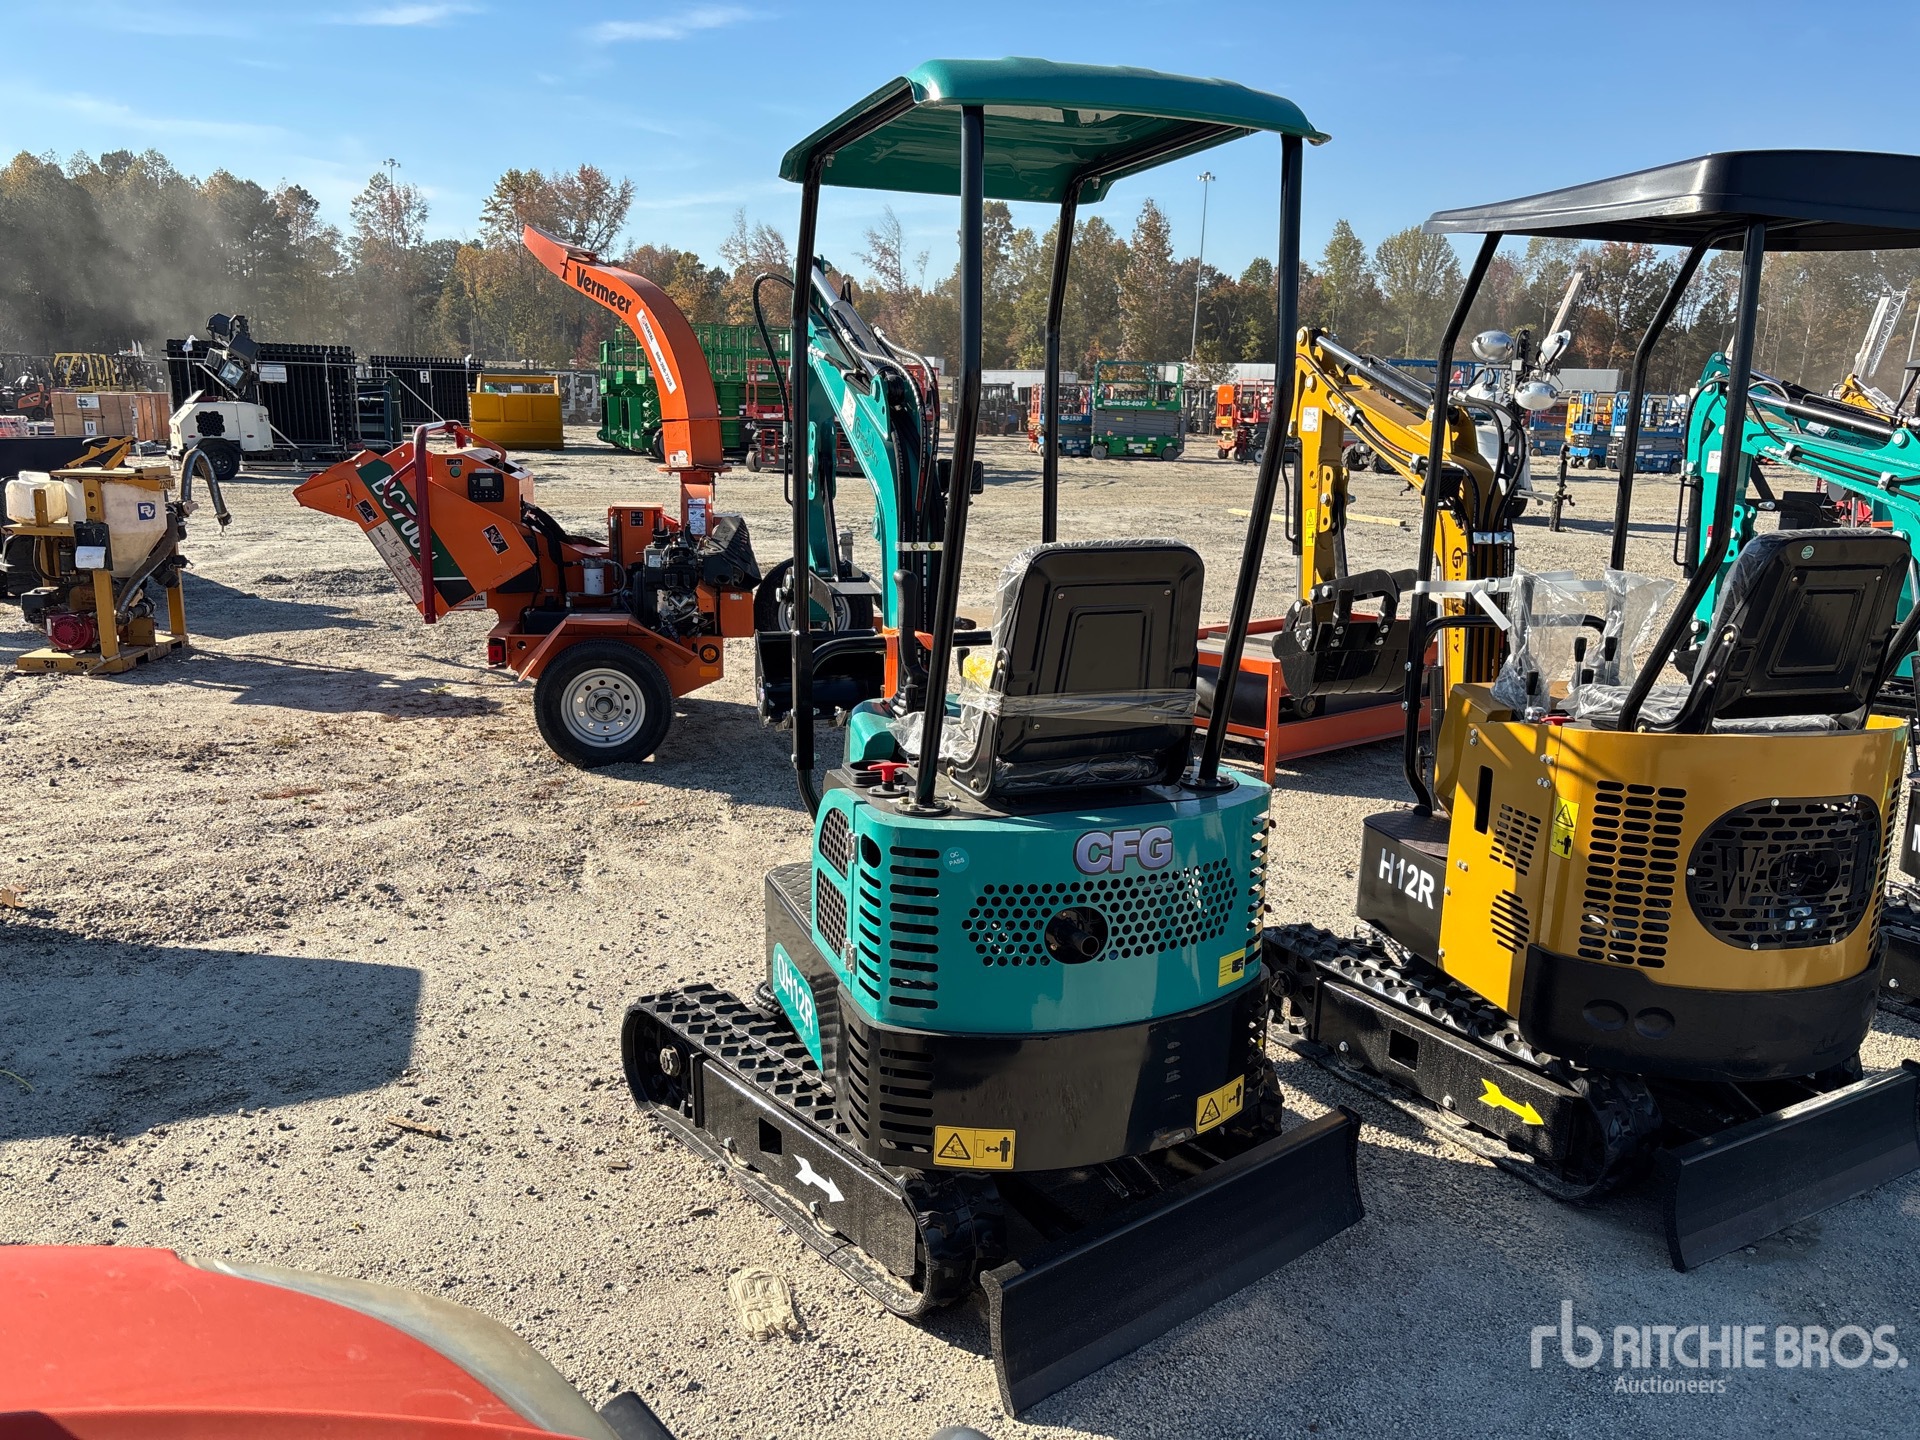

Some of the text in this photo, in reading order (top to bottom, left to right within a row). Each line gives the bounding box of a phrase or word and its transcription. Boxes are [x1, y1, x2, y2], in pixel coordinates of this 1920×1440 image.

[576, 265, 633, 315] Vermeer
[948, 857, 965, 867] PASS
[1073, 826, 1173, 875] CFG
[1378, 847, 1435, 910] H12R
